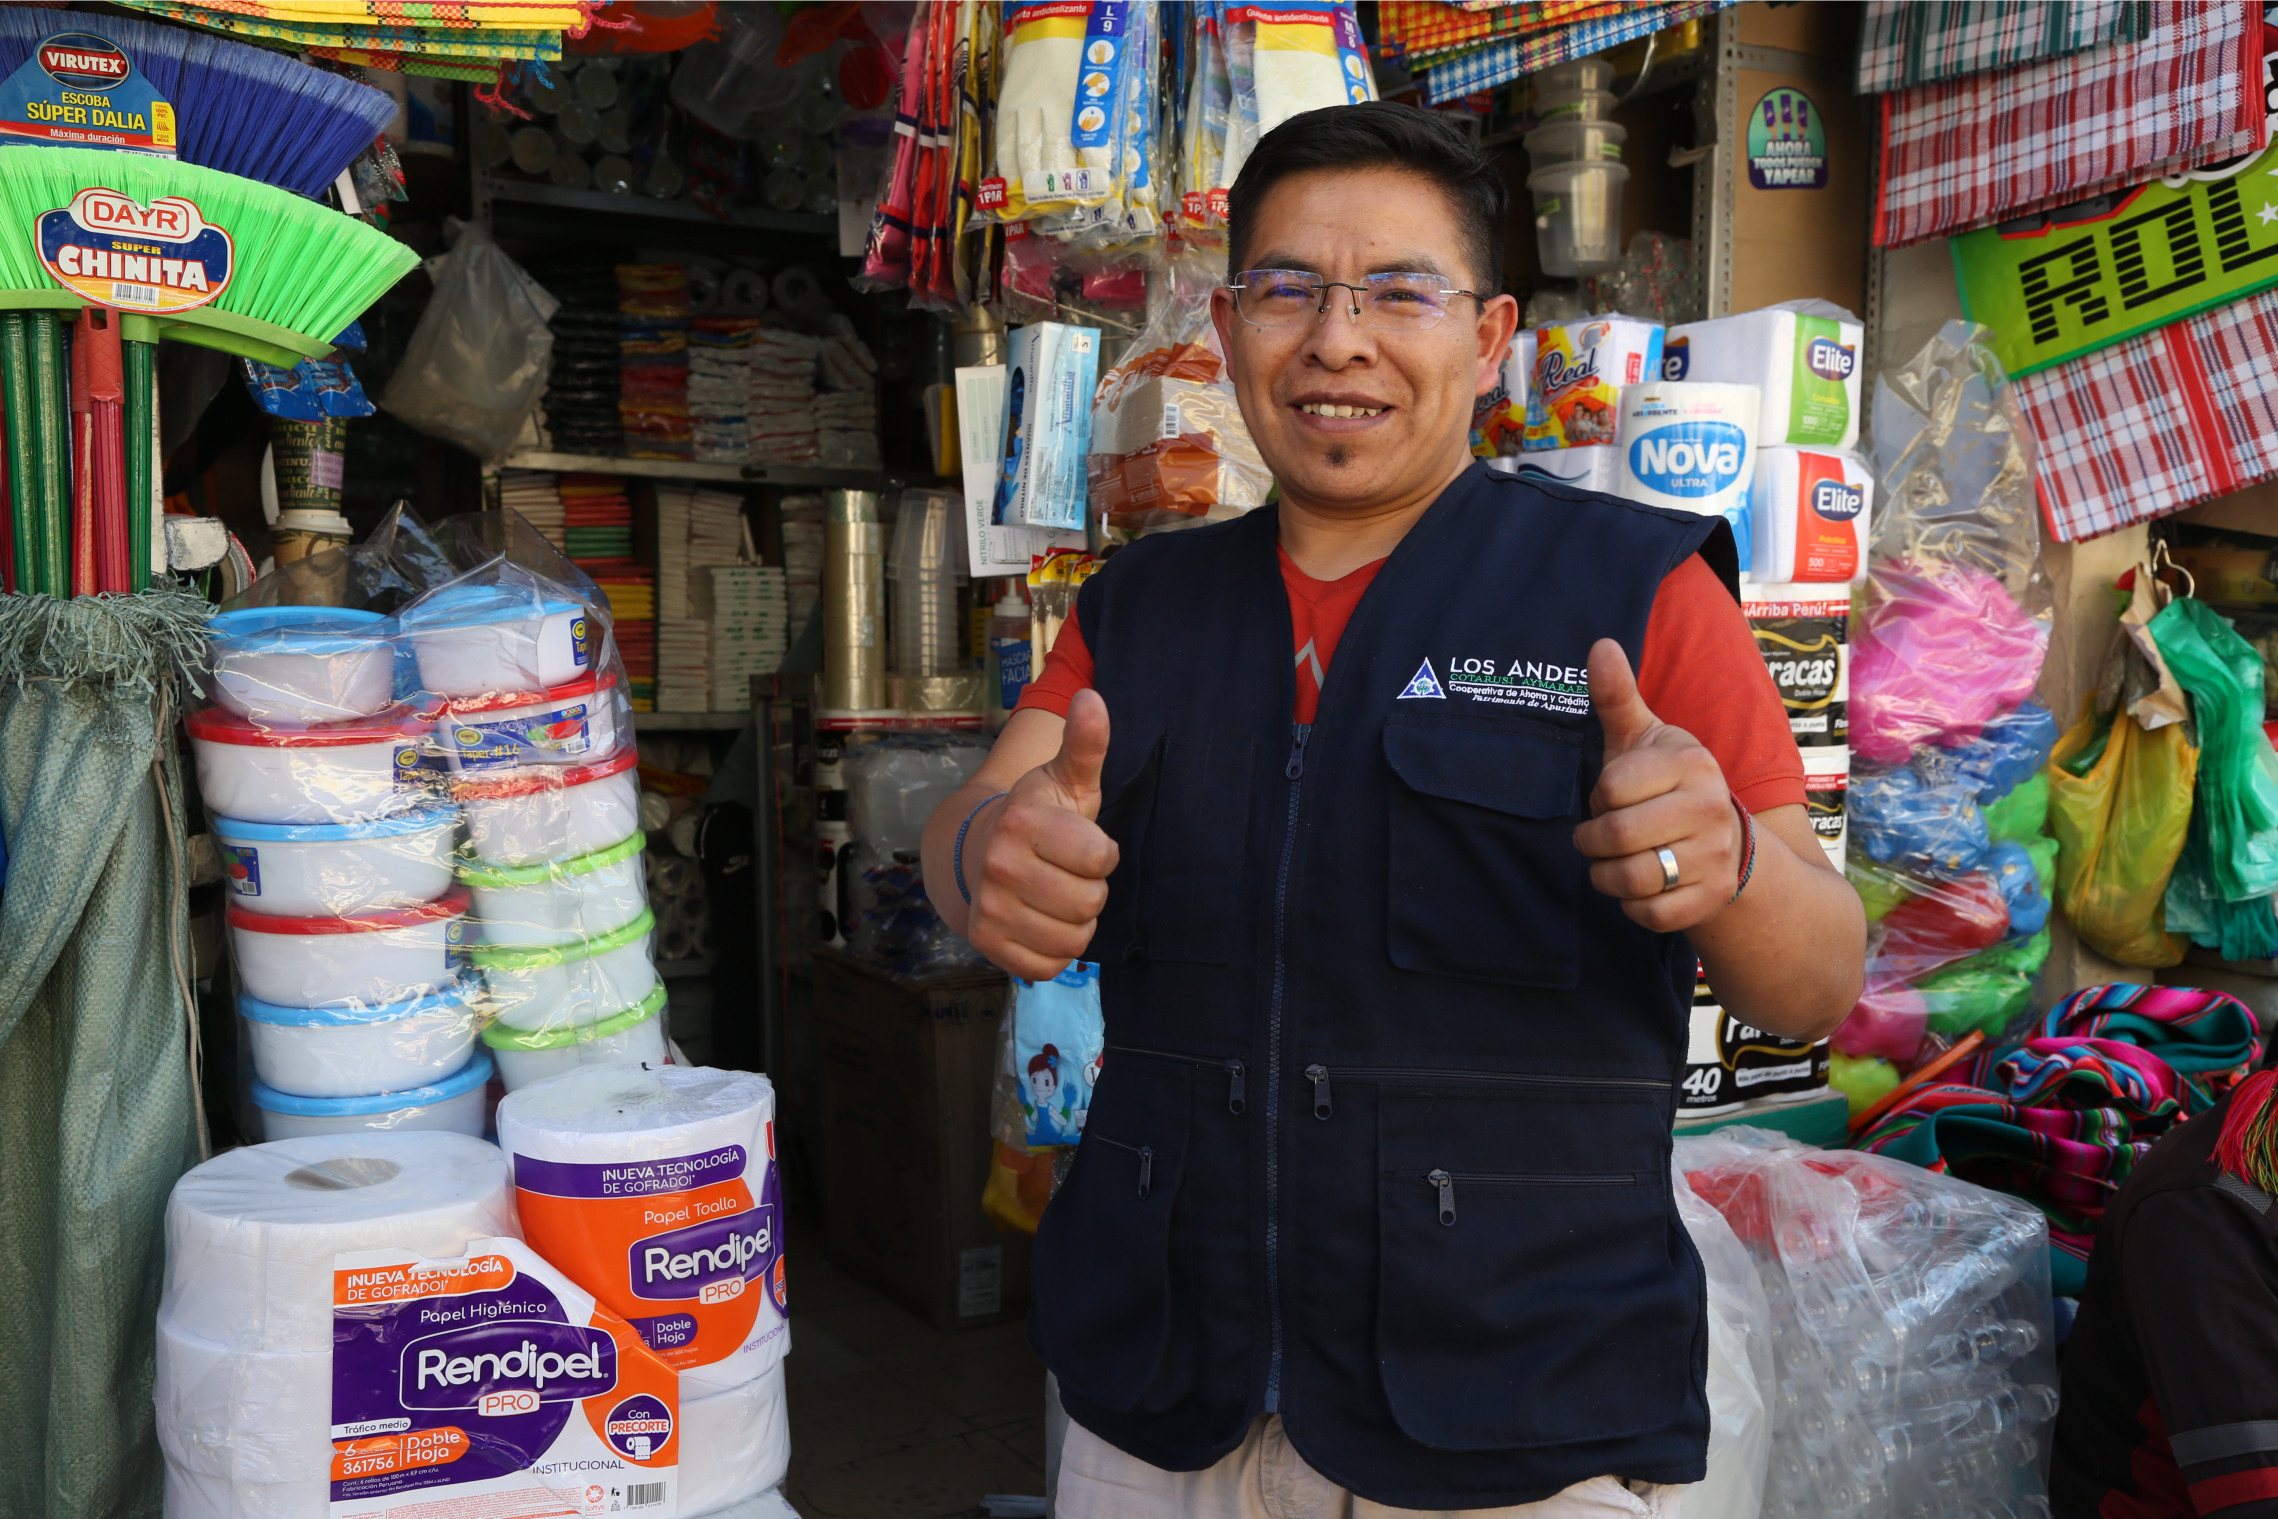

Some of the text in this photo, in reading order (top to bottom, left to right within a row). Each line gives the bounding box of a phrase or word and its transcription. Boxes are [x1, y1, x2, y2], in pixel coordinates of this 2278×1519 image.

[1032, 4, 1087, 18] antideslizante
[1106, 5, 1114, 17] L
[1274, 11, 1330, 23] antideslizante
[1103, 20, 1113, 33] 9
[46, 51, 122, 75] VIRUTEX
[62, 92, 111, 108] ESCOBA
[27, 100, 147, 131] SÚPER DALIA
[50, 128, 126, 144] Máxima duración
[1766, 141, 1812, 156] AHORA
[1754, 157, 1786, 169] TODOS
[1764, 168, 1815, 185] YAPEAR
[93, 200, 179, 231] DAYR
[111, 241, 162, 255] SUPER
[57, 244, 210, 293] CHINITA
[1812, 344, 1852, 374] Elite
[1536, 347, 1601, 399] Real
[1024, 423, 1032, 467] GUANTES
[1640, 438, 1739, 476] Nova
[1023, 467, 1028, 480] DE
[1671, 478, 1708, 488] ULTRA
[1817, 487, 1860, 513] Elite
[976, 499, 985, 529] VERDE
[979, 530, 988, 565] NITRILO
[1744, 602, 1827, 617] ¡Arriba Perú!
[1002, 665, 1032, 685] FACIA
[1450, 657, 1588, 685] LOS ANDES
[1450, 673, 1589, 694] COTARUSI AYMARAES
[1449, 684, 1590, 708] Cooperativa de Ahorro y Crédito
[1472, 694, 1588, 715] Patrimonio de Apurímac
[463, 743, 521, 761] Taper #16
[1682, 1067, 1722, 1095] 40
[603, 1148, 739, 1182] ¡NUEVA TECNOLOGÍA
[603, 1182, 620, 1194] DE
[644, 1197, 737, 1226] Papel Toalla
[645, 1215, 772, 1283] Rendipel
[347, 1270, 406, 1289] ¡NUEVA
[348, 1289, 367, 1301] DE
[705, 1280, 742, 1302] PRO
[420, 1301, 547, 1325] Papel Higiénico
[657, 1320, 692, 1333] Doble
[657, 1332, 686, 1344] Hoja
[417, 1340, 603, 1390] Rendipel
[485, 1394, 534, 1414] PRO
[628, 1410, 650, 1419] Con
[344, 1421, 408, 1435] Tráfico medio
[610, 1420, 667, 1433] PRECORTE
[407, 1430, 461, 1450] Doble
[344, 1443, 357, 1457] 6
[406, 1446, 450, 1463] Hoja
[342, 1456, 395, 1475] 361756
[532, 1460, 625, 1474] INSTITUCIONAL
[342, 1480, 403, 1492] Fabricación Peruana
[584, 1504, 605, 1512] Softys
